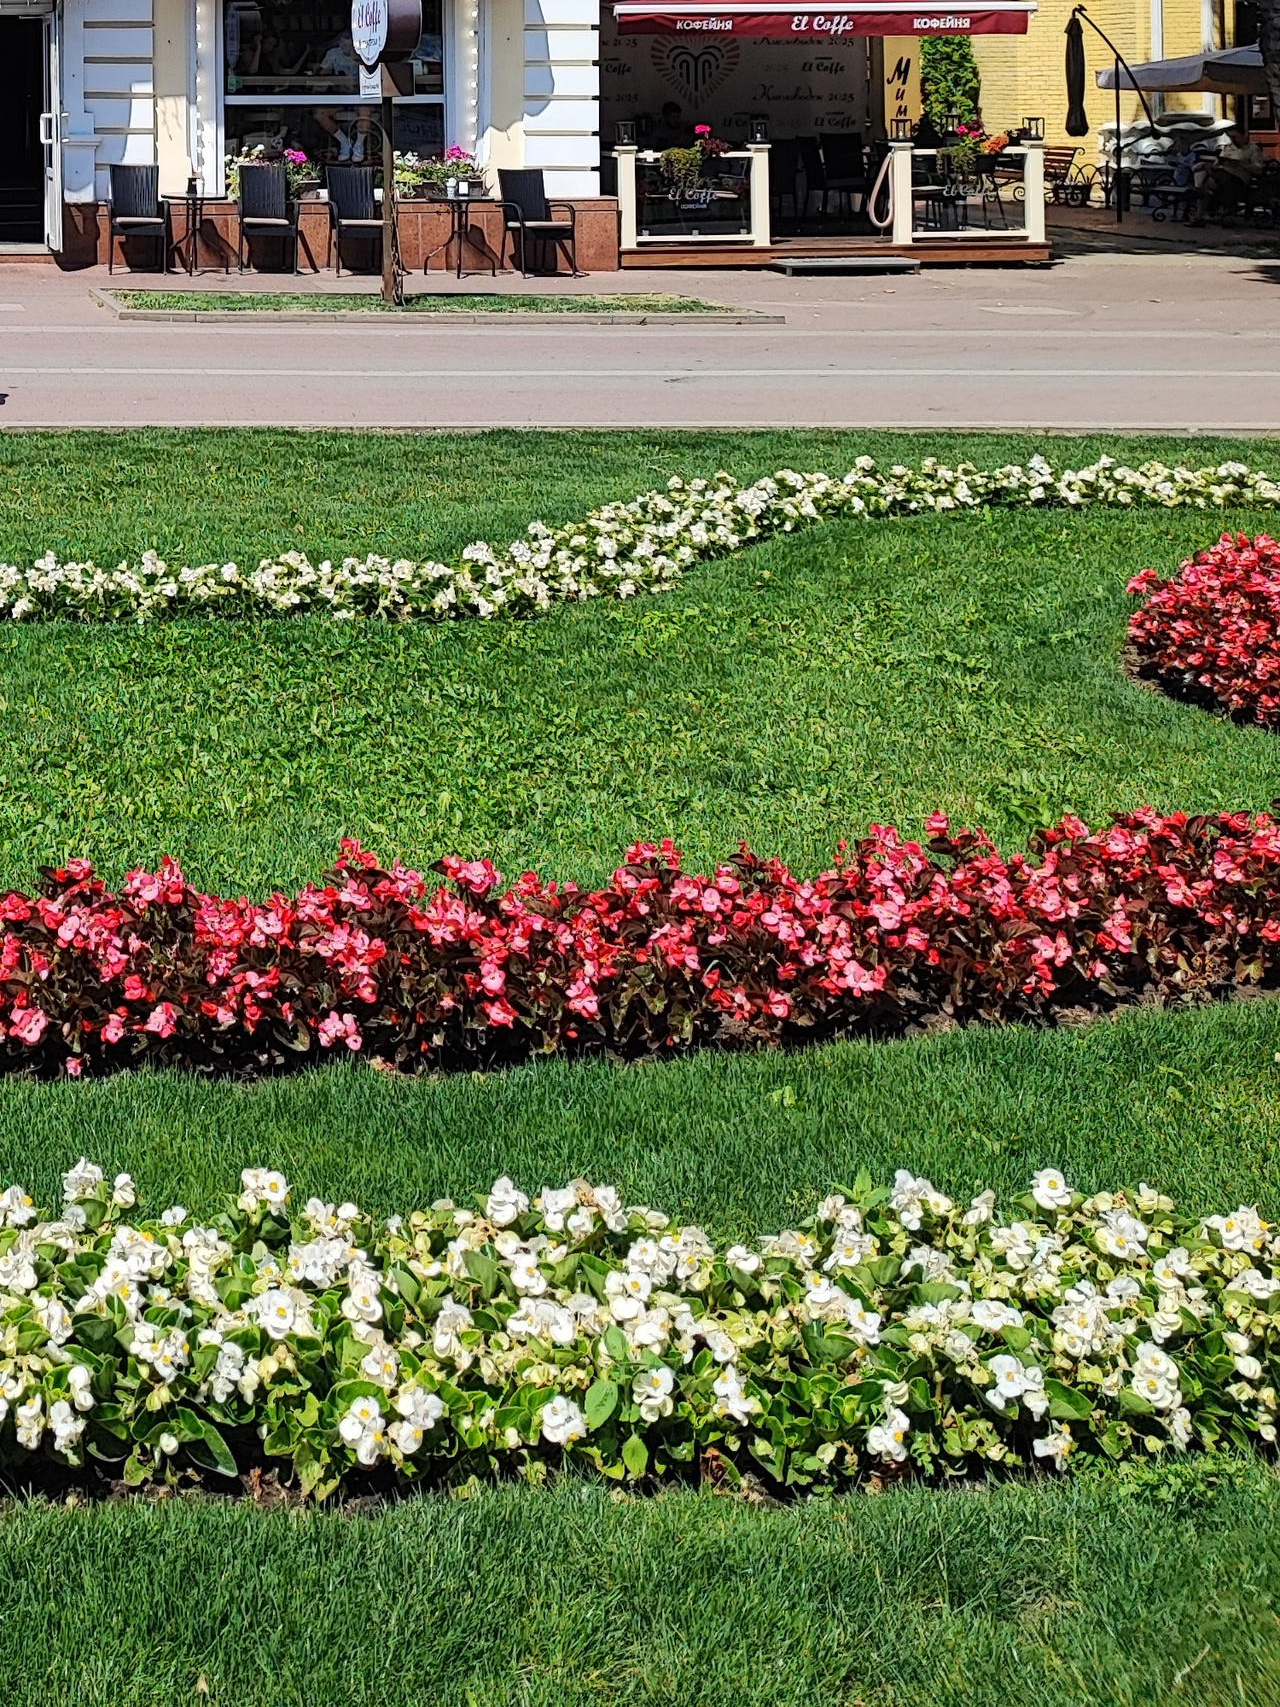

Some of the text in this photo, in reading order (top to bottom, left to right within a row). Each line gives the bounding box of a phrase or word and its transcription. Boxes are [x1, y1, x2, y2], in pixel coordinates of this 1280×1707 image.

[676, 17, 733, 30] КОФЕЙНЯ
[791, 16, 808, 31] El
[913, 16, 971, 29] КОФЕЙНЯ
